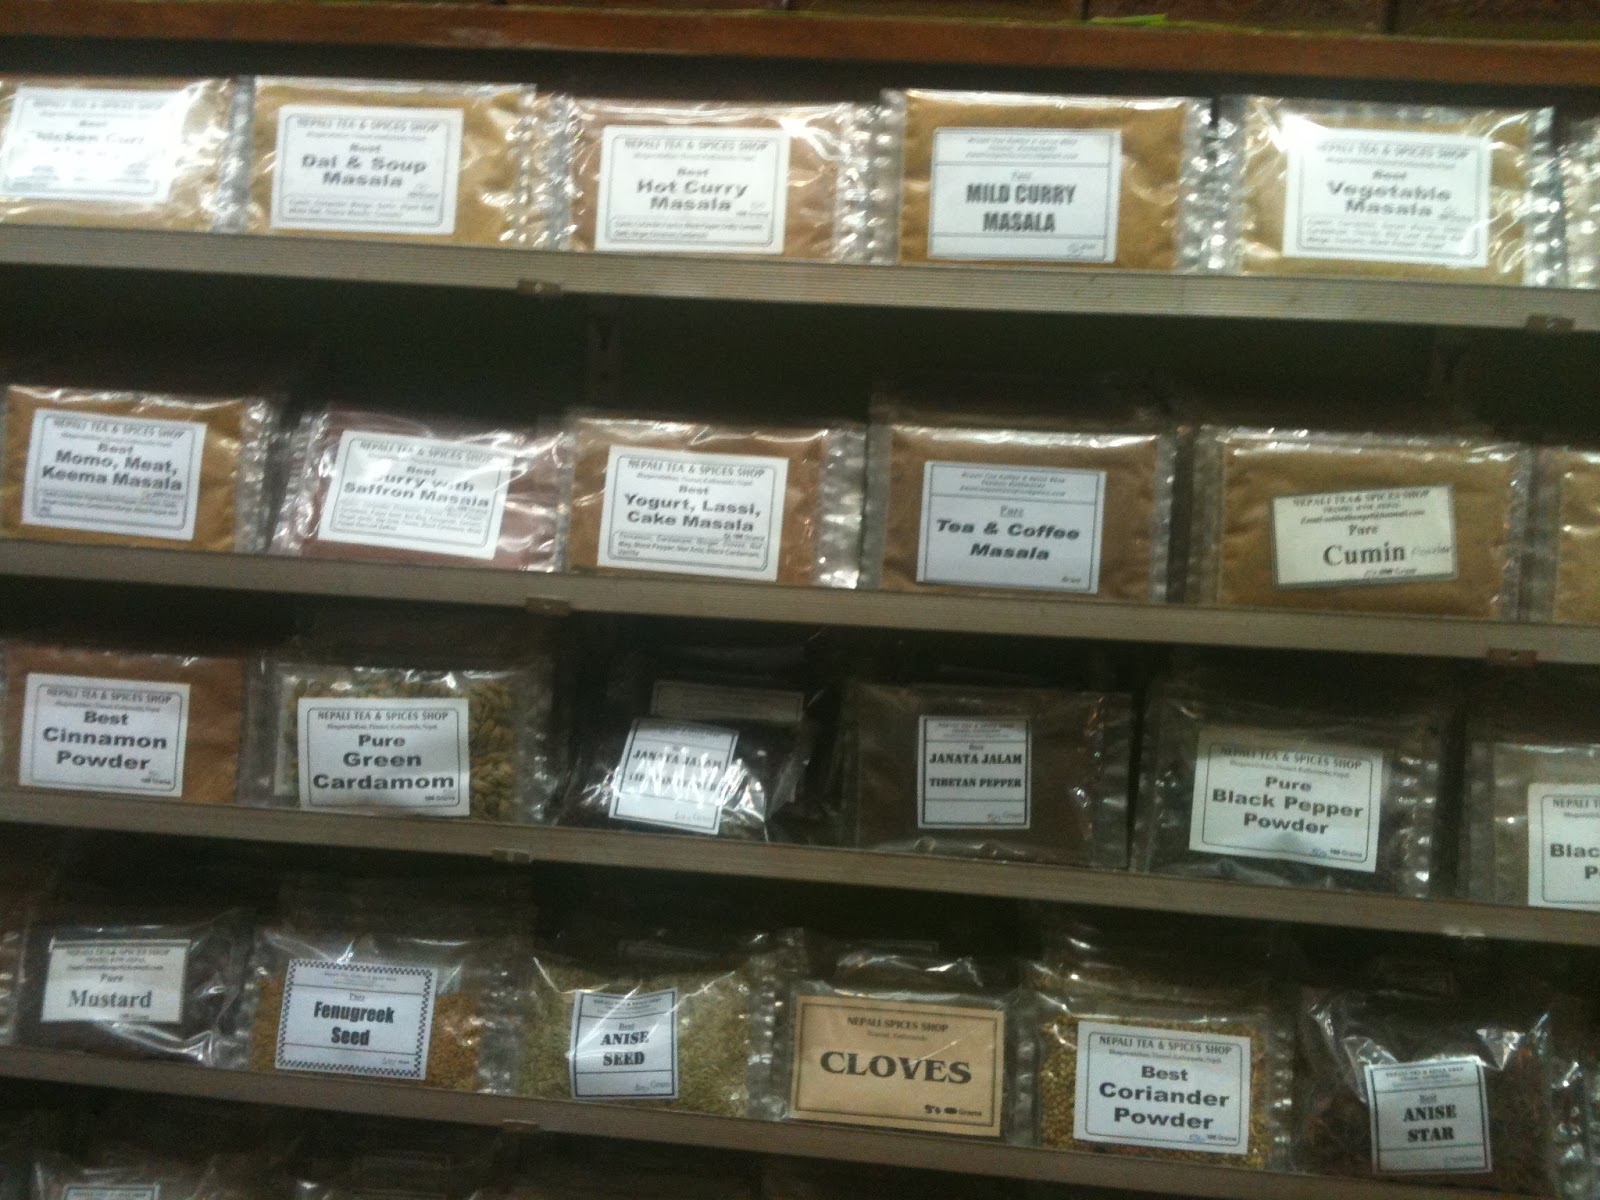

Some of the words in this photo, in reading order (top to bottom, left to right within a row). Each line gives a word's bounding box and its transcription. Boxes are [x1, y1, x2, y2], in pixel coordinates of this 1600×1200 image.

[301, 153, 338, 168] Dal
[345, 155, 361, 170] &
[370, 157, 427, 175] Soup
[322, 170, 403, 188] Masala
[636, 179, 676, 194] Hot
[682, 180, 749, 199] Curry
[966, 182, 1010, 204] MILD
[1014, 183, 1077, 206] CURRY
[1326, 181, 1451, 201] Vegetable
[650, 195, 732, 211] Masala
[1345, 199, 1432, 216] Masala
[982, 210, 1057, 232] MASALA
[55, 449, 118, 470] Momo,
[124, 456, 178, 476] Meat,
[42, 465, 107, 485] Keema
[112, 472, 182, 491] Masala
[344, 481, 415, 499] Saffron
[420, 489, 489, 508] Masala
[624, 492, 696, 513] Yogurt,
[702, 499, 761, 518] Lassi,
[627, 510, 676, 527] Cake
[683, 515, 754, 532] Masala
[936, 518, 976, 533] Tea
[984, 521, 999, 536] &
[1007, 522, 1081, 540] Coffee
[969, 543, 1050, 561] Masala
[1322, 540, 1406, 567] Cumin
[83, 710, 129, 726] Best
[42, 726, 167, 750] Cinnamon
[358, 734, 406, 748] Pure
[56, 749, 151, 770] Powder
[343, 751, 422, 768] Green
[313, 774, 454, 790] Cardamom
[1265, 775, 1313, 793] Pure
[1212, 787, 1276, 808] Black
[1284, 795, 1364, 819] Pepper
[1243, 811, 1329, 835] Powder
[1550, 842, 1600, 858] Blac
[69, 989, 152, 1008] Mustard
[313, 1001, 395, 1024] Fenugreek
[331, 1027, 371, 1046] Seed
[600, 1030, 650, 1046] ANISE
[603, 1051, 645, 1066] SEED
[820, 1050, 972, 1085] CLOVES
[1141, 1065, 1189, 1082] Best
[1099, 1082, 1230, 1107] Coriander
[1114, 1106, 1215, 1130] Powder
[1403, 1104, 1457, 1122] ANISE
[1407, 1126, 1455, 1143] STAR
